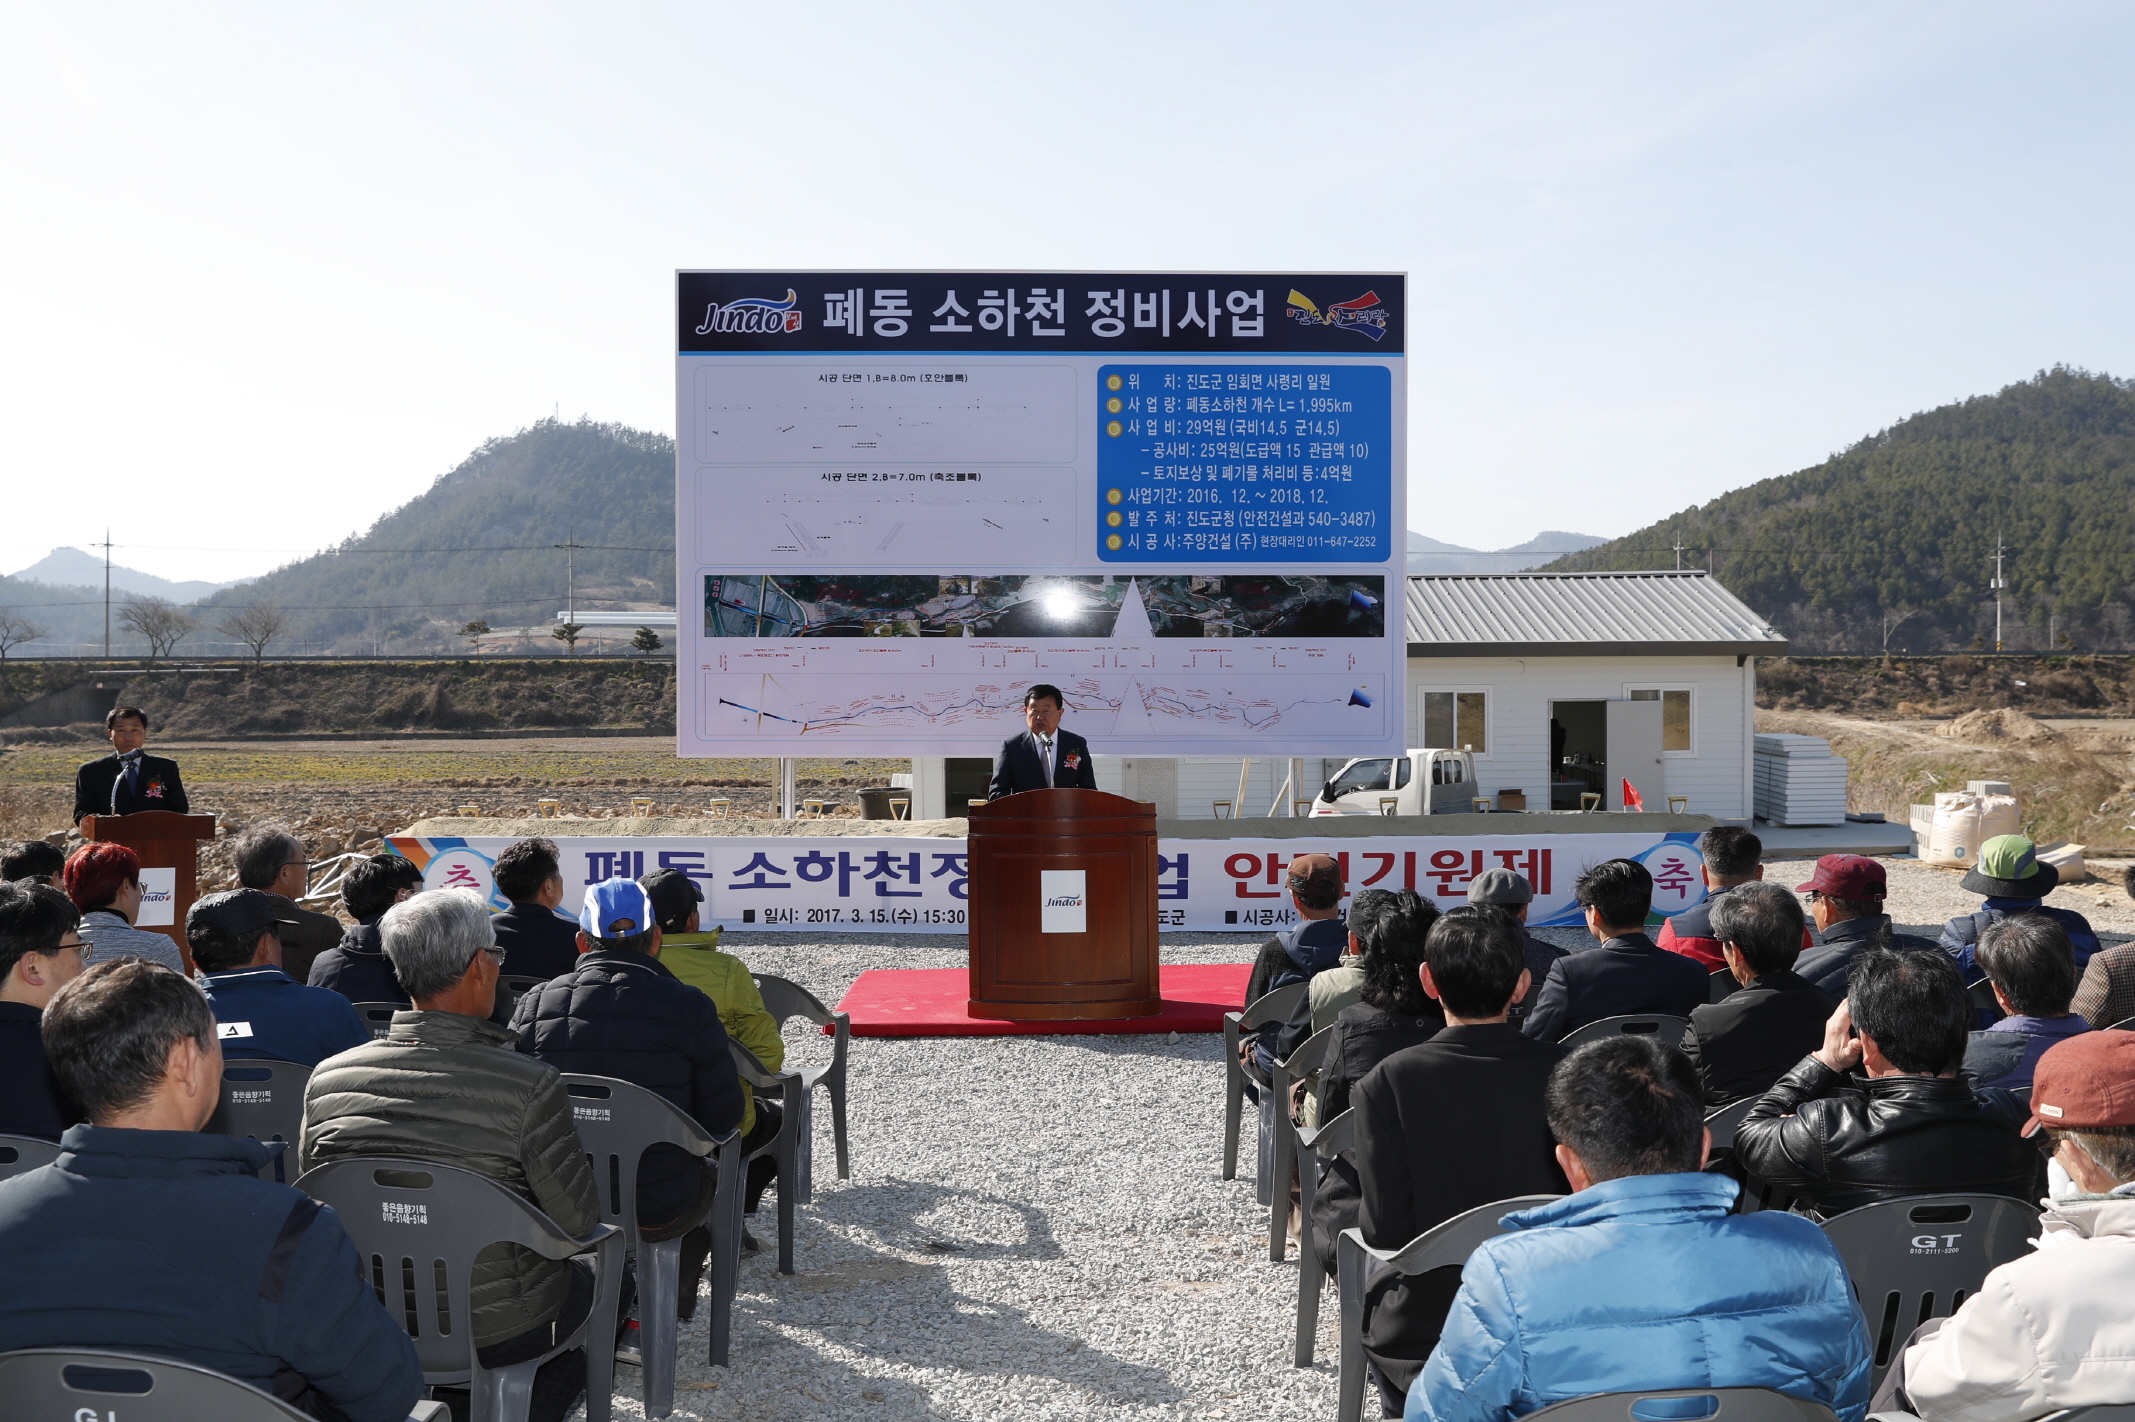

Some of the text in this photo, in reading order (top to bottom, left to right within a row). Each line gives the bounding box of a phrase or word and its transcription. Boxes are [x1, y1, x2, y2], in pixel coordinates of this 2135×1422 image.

[696, 302, 786, 335] Jindo
[823, 288, 1264, 338] 폐동 소하천 정비사업
[818, 374, 838, 383] 시공
[842, 374, 862, 383] 단면
[1128, 374, 1140, 390] 위
[1187, 374, 1222, 390] 진도군
[1226, 374, 1262, 390] 임회면
[1266, 374, 1302, 390] 사령리
[1307, 374, 1330, 390] 일원
[1186, 396, 1247, 413] 폐동소하천
[1251, 396, 1275, 413] 개수
[1186, 419, 1226, 436] 29억원
[1230, 419, 1287, 436] (국비14.5
[1295, 419, 1340, 436] 군14.5)
[1153, 441, 1195, 459] 공사비:
[1286, 443, 1301, 458] 15
[1308, 441, 1344, 459] 관급액
[1349, 441, 1369, 459] 10)
[821, 473, 842, 482] 시공
[846, 473, 867, 482] 단면
[1153, 464, 1202, 481] 토지보상
[1206, 464, 1217, 481] 및
[1222, 464, 1258, 481] 폐기물
[1262, 464, 1297, 481] 처리비
[1128, 488, 1182, 504] 사업기간:
[1187, 488, 1222, 504] 2016.
[1231, 488, 1250, 504] 12.
[1270, 488, 1305, 504] 2018.
[1310, 488, 1328, 504] 12.
[1187, 510, 1235, 527] 진도군청
[1239, 510, 1304, 527] (안전건설과
[1308, 510, 1376, 527] 540-3487)
[1235, 533, 1257, 550] (주)
[1260, 535, 1305, 548] 현장대리인
[1307, 536, 1376, 547] 011-647-2252
[1653, 857, 1694, 899] 축
[1045, 898, 1076, 907] Jindo
[764, 908, 799, 924] 일시:
[807, 908, 844, 924] 2017.
[851, 909, 864, 923] 3.
[924, 909, 965, 924] 15:30
[1243, 909, 1296, 926] 시공사:
[1911, 1233, 1962, 1248] GT
